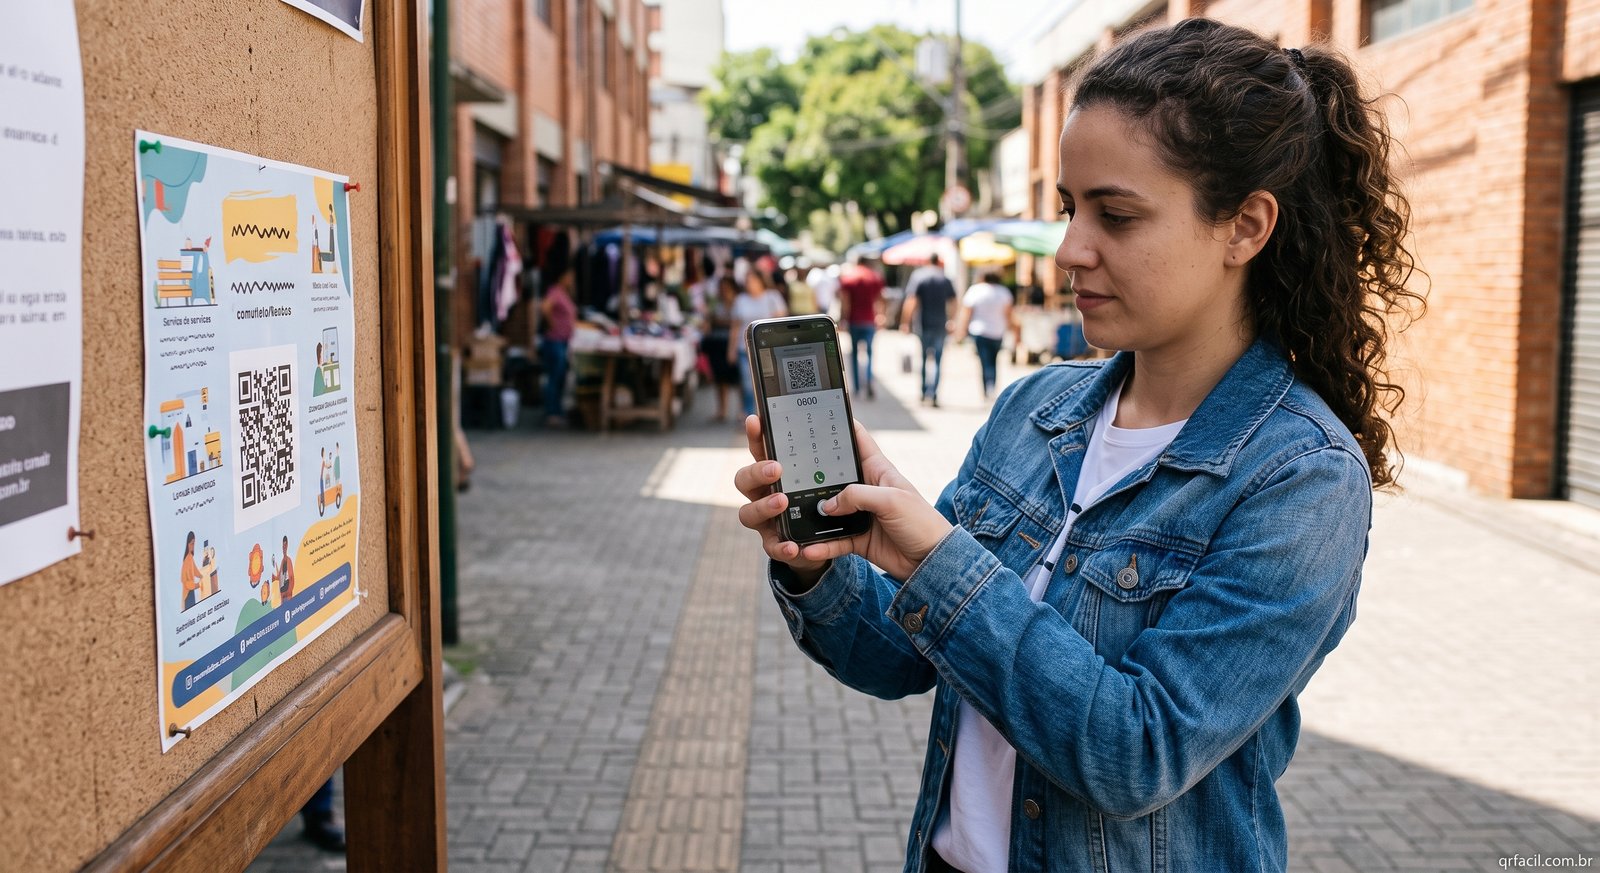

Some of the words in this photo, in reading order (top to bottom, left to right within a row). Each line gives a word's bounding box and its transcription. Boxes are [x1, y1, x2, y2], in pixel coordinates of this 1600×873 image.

[796, 396, 818, 407] 0800
[828, 409, 834, 417] 3
[809, 427, 815, 435] 5
[831, 424, 837, 432] 6
[811, 442, 817, 450] 8
[833, 439, 839, 447] 9
